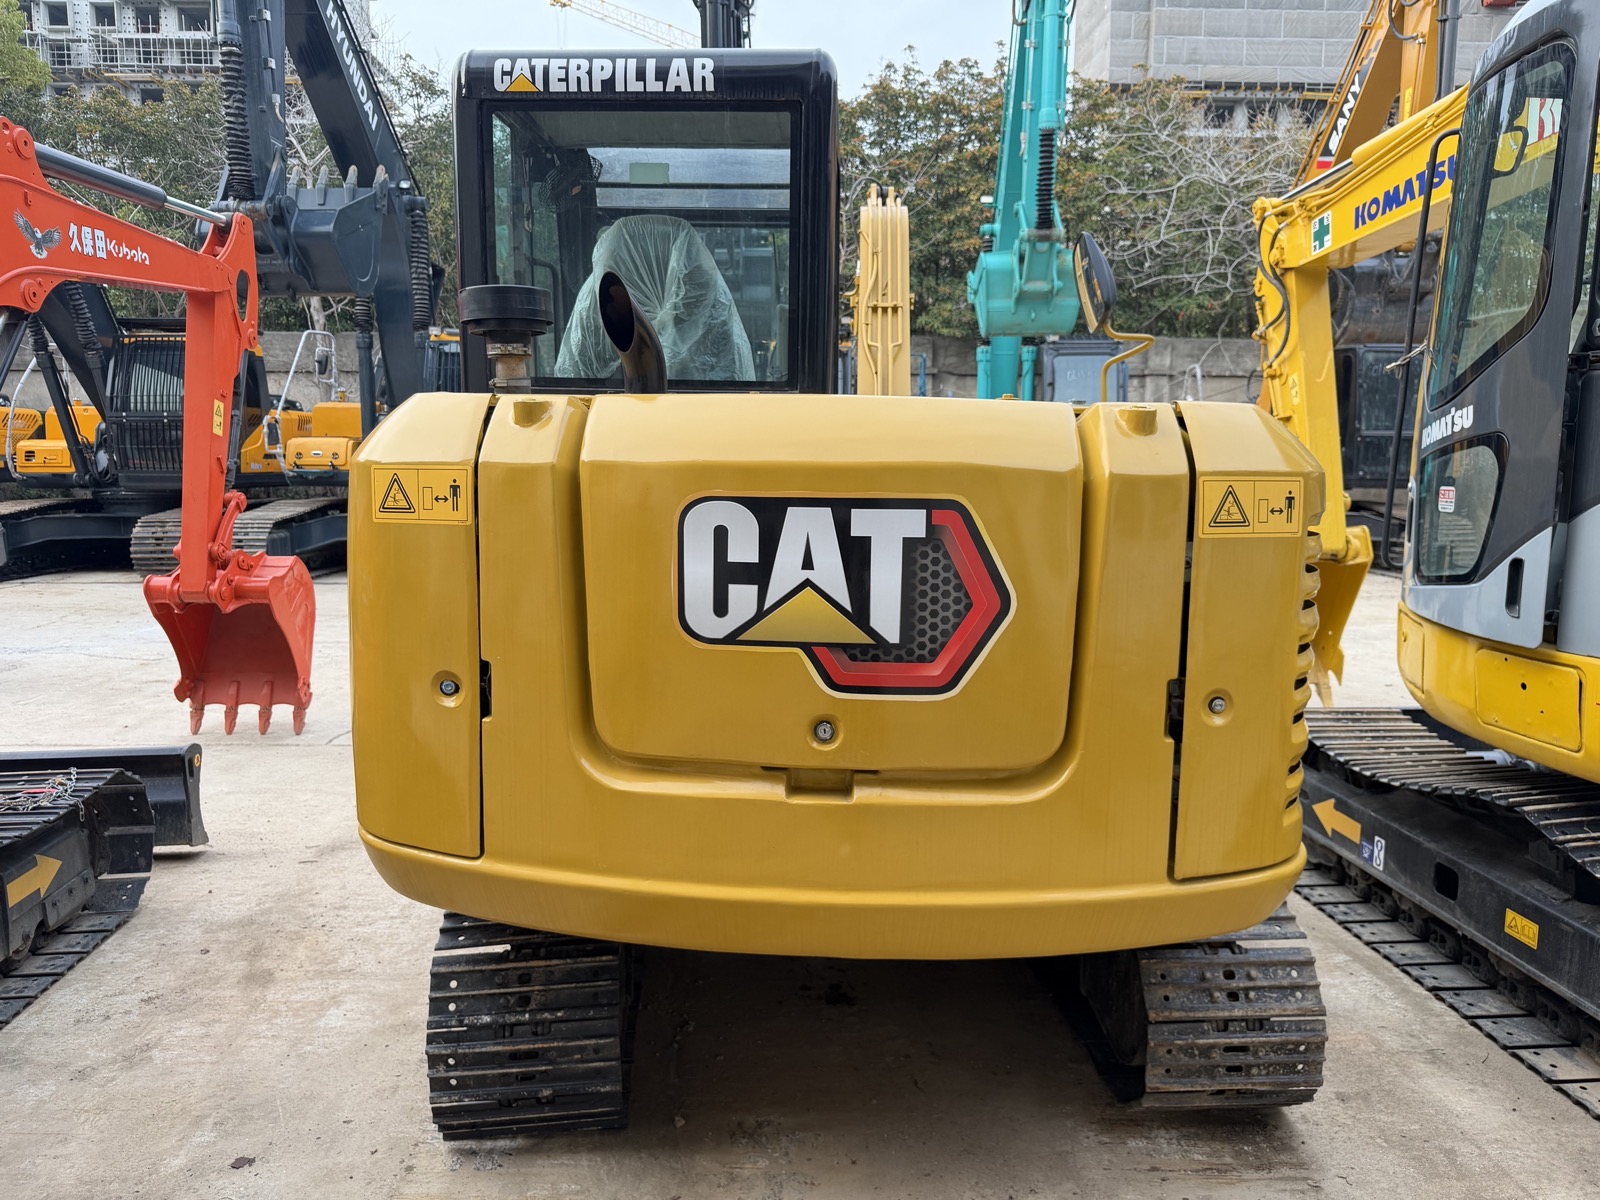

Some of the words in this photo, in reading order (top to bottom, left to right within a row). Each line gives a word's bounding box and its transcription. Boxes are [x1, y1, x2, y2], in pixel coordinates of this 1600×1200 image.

[326, 0, 378, 131] HYUNDAI
[493, 57, 715, 93] CATERPILLAR
[1328, 72, 1360, 155] SANY
[68, 222, 108, 260] 久保田
[106, 237, 150, 266] Kubota
[1421, 404, 1474, 449] KOMATSU
[683, 500, 927, 644] CAT
